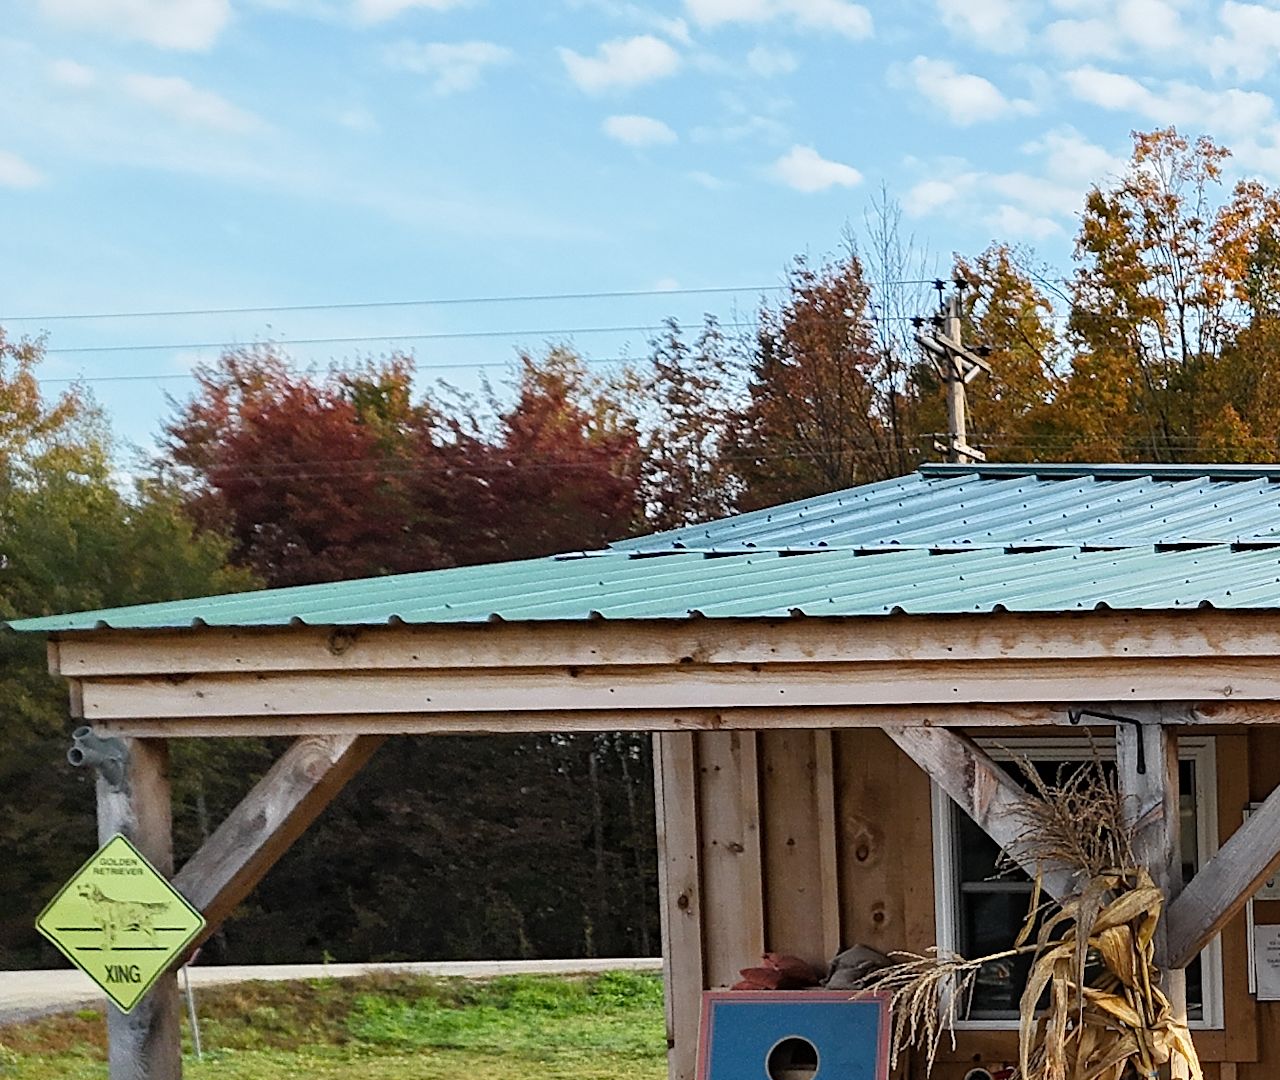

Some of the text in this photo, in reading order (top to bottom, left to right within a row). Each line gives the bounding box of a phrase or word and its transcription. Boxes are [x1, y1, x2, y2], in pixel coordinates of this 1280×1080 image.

[99, 857, 138, 866] GOLDEN
[93, 867, 144, 876] RETRIEVER
[104, 964, 142, 984] XING
